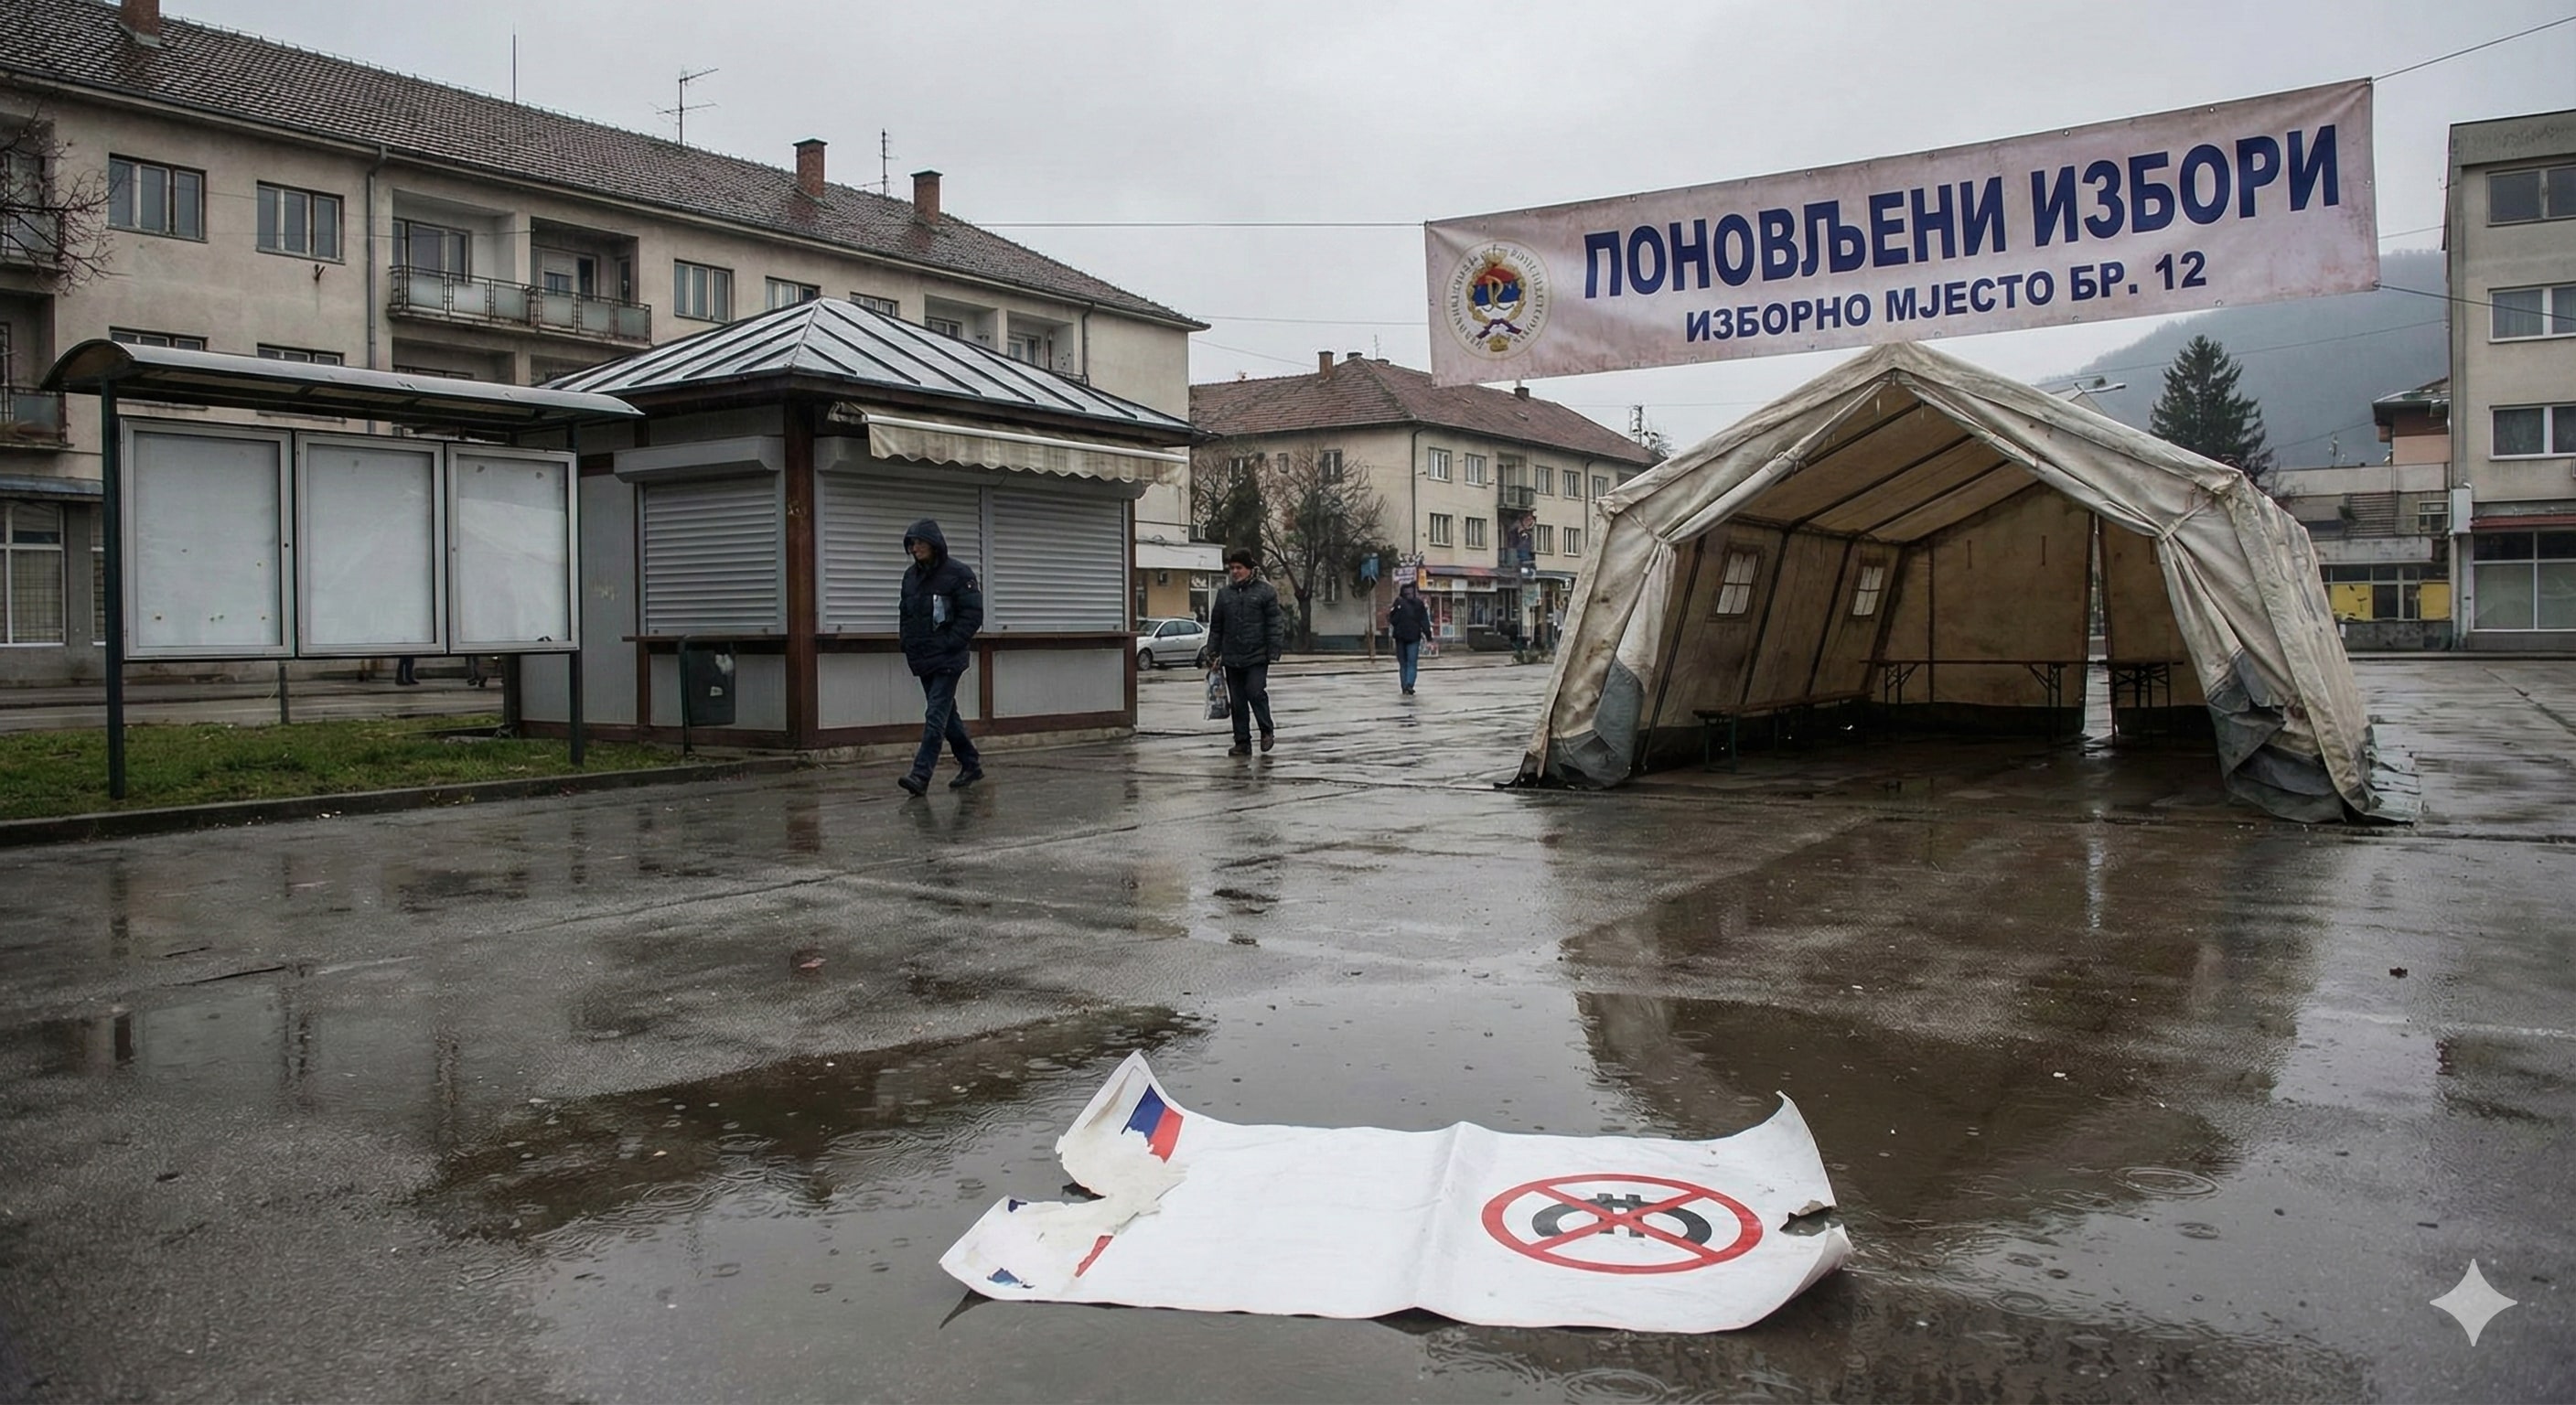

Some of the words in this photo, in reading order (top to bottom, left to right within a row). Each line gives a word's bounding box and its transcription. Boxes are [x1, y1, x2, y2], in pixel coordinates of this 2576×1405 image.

[1584, 177, 2007, 299] ПОНОВЉЕНИ
[2031, 124, 2339, 246] ИЗБОРИ
[1686, 293, 1873, 342] ИЗБОРНО
[1886, 271, 2055, 321] МЈЕСТО
[2070, 262, 2139, 301] БР.
[2152, 251, 2206, 291] 12
